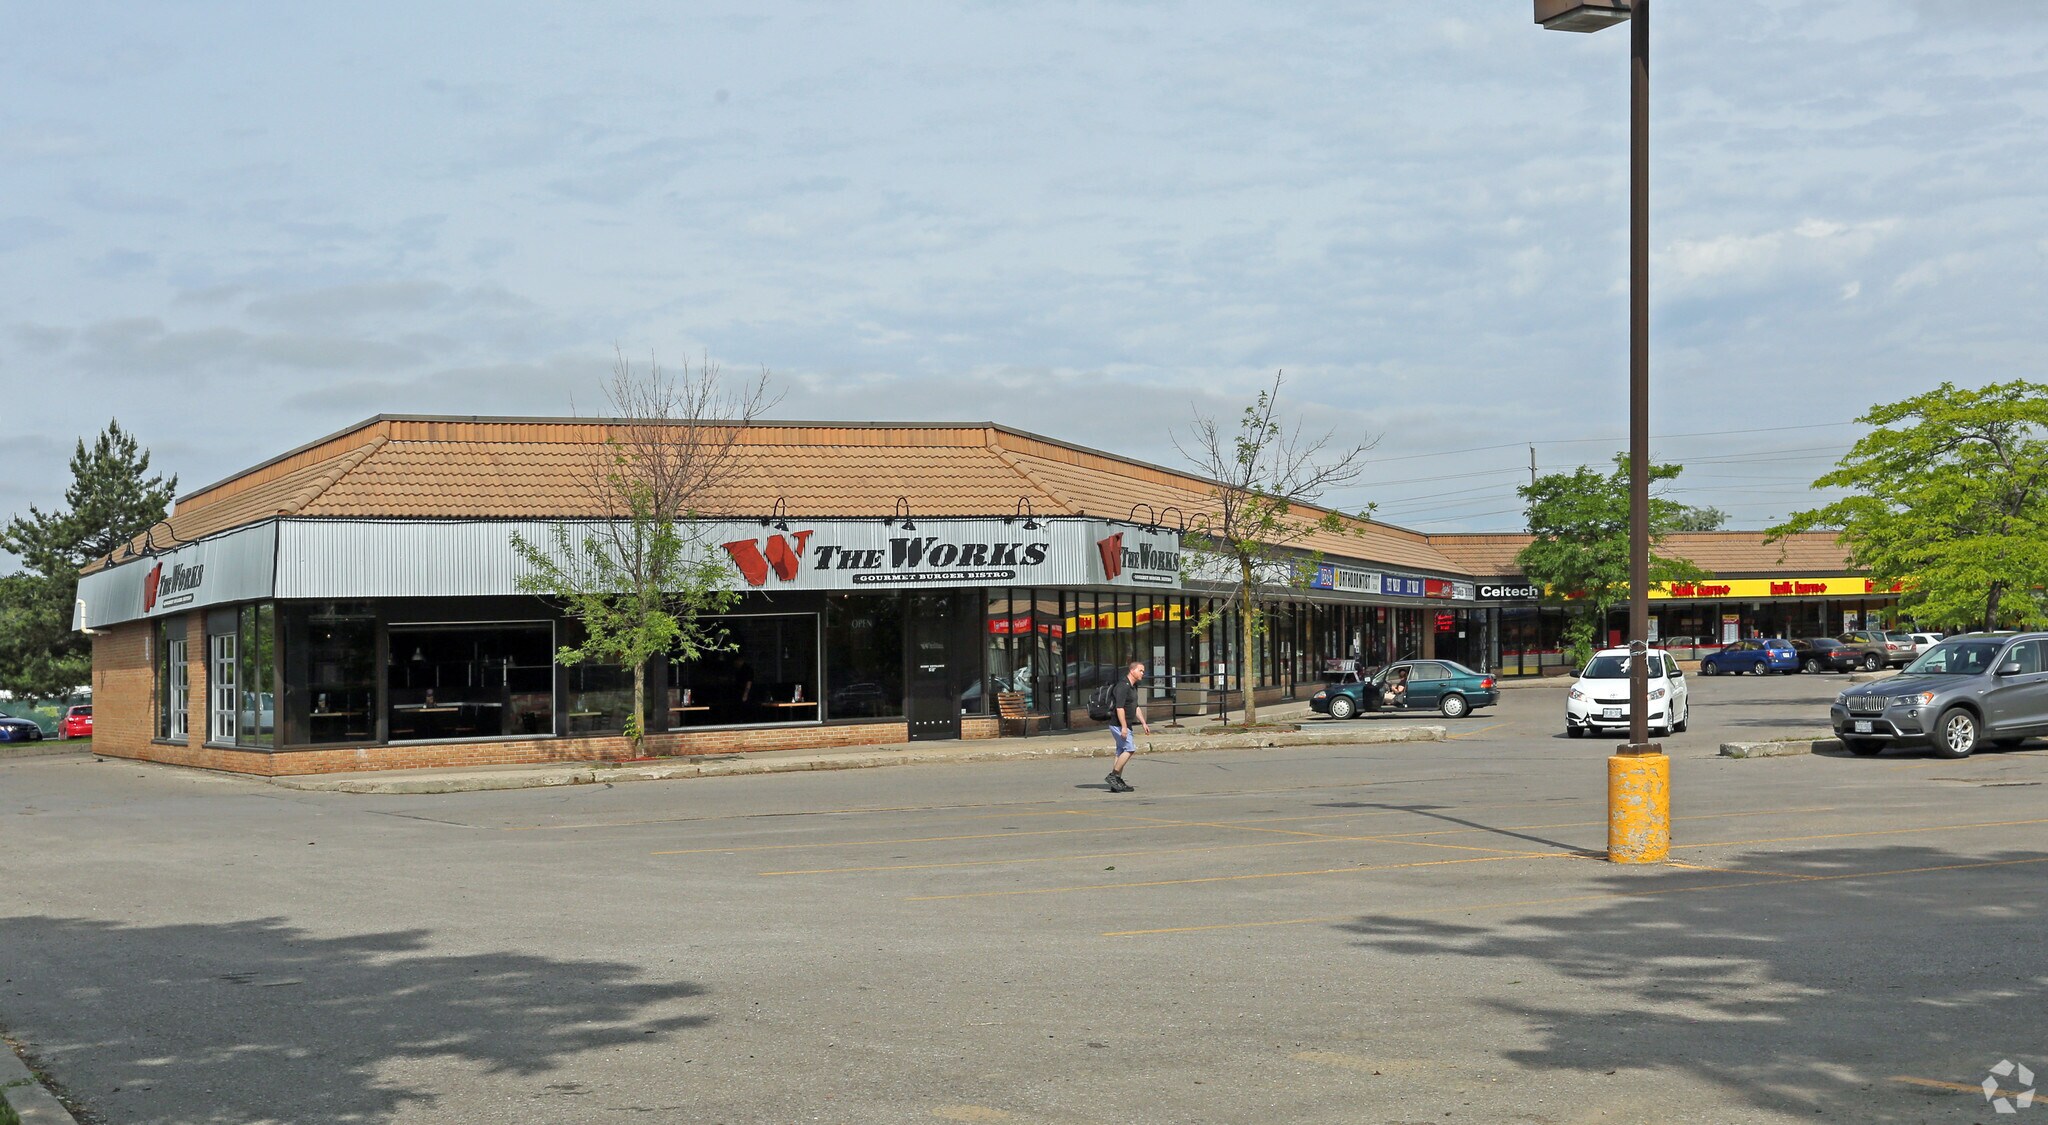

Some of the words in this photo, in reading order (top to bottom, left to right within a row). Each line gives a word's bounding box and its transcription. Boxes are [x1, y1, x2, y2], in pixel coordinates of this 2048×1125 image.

[814, 545, 885, 570] THE
[889, 537, 1050, 568] WORKS
[1121, 546, 1139, 569] THE
[1139, 543, 1180, 572] WORKS
[158, 574, 172, 597] THE
[171, 563, 204, 594] WORKS
[1339, 570, 1371, 589] ORTHODONTIST
[1480, 585, 1538, 597] Celtech
[1770, 581, 1793, 595] bulk
